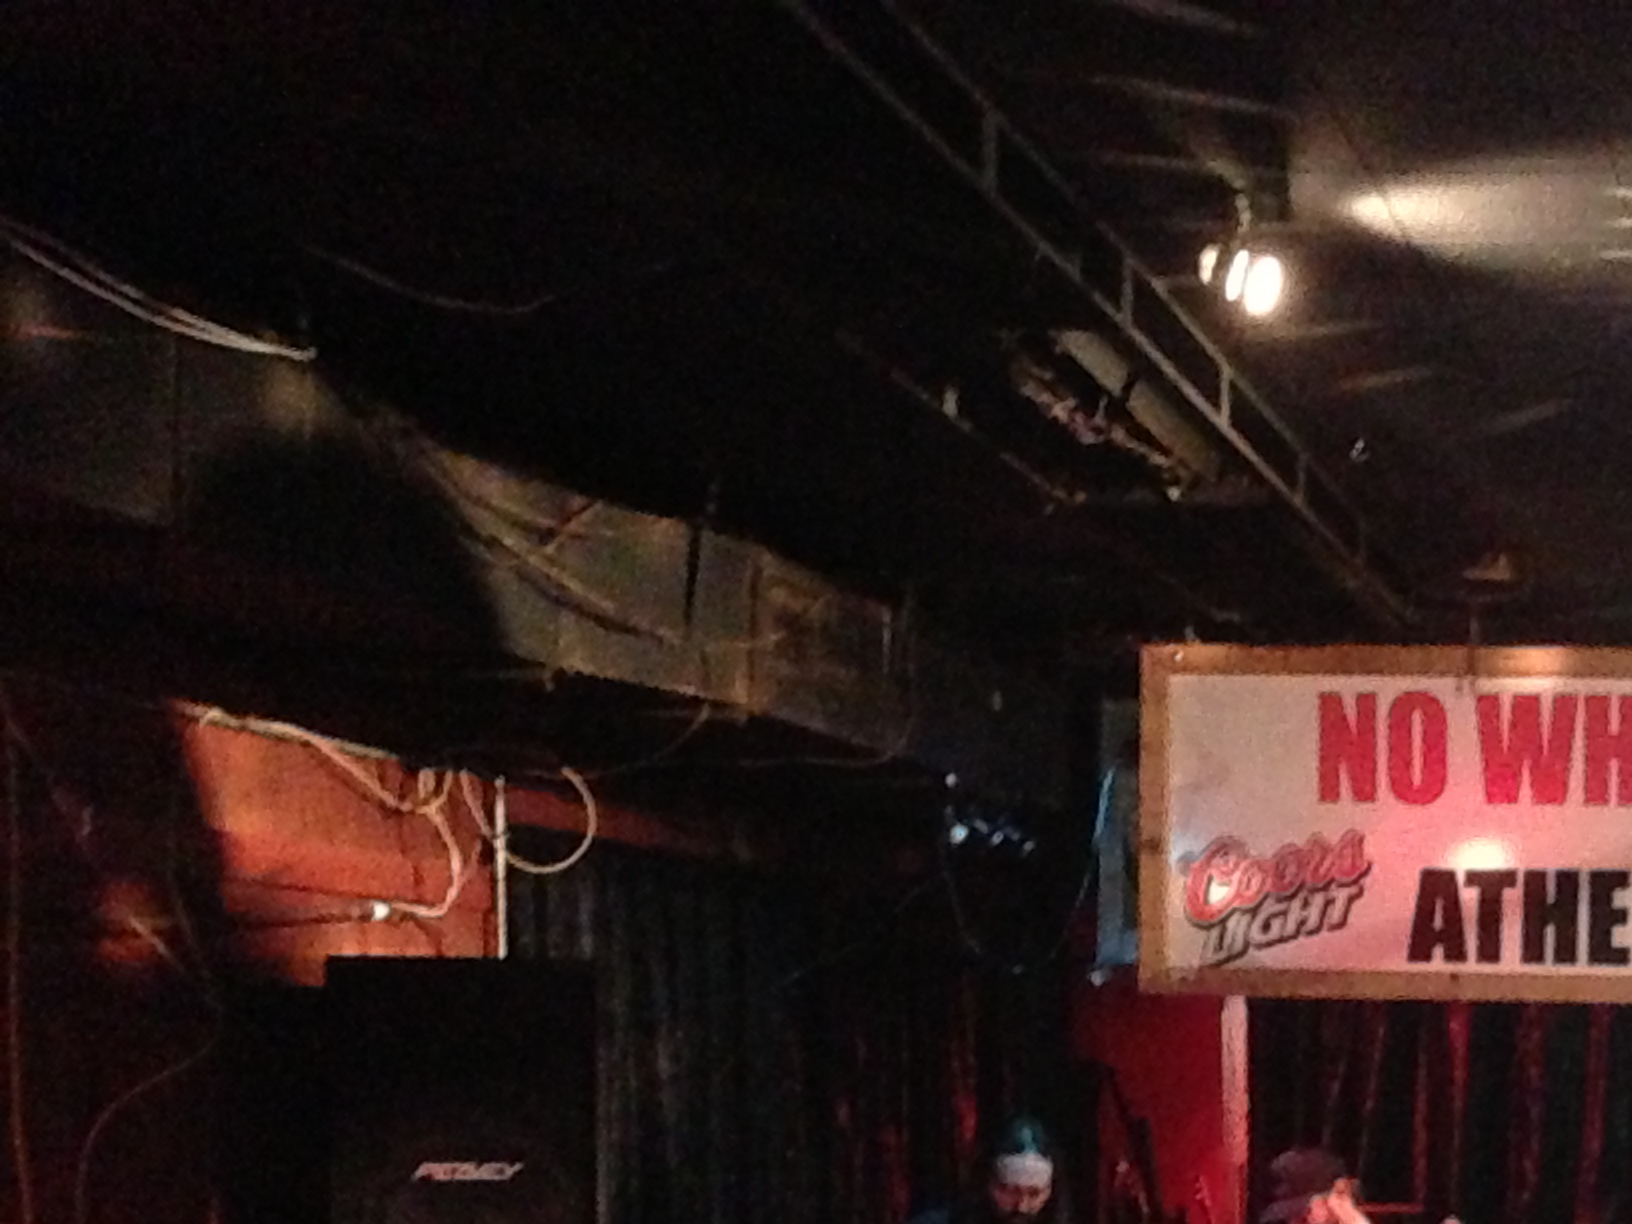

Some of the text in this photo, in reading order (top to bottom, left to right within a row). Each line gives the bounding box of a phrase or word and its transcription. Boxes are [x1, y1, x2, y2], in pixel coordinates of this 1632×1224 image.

[1318, 691, 1449, 805] NO
[1183, 831, 1371, 928] Coors
[1201, 882, 1364, 967] LIGHT
